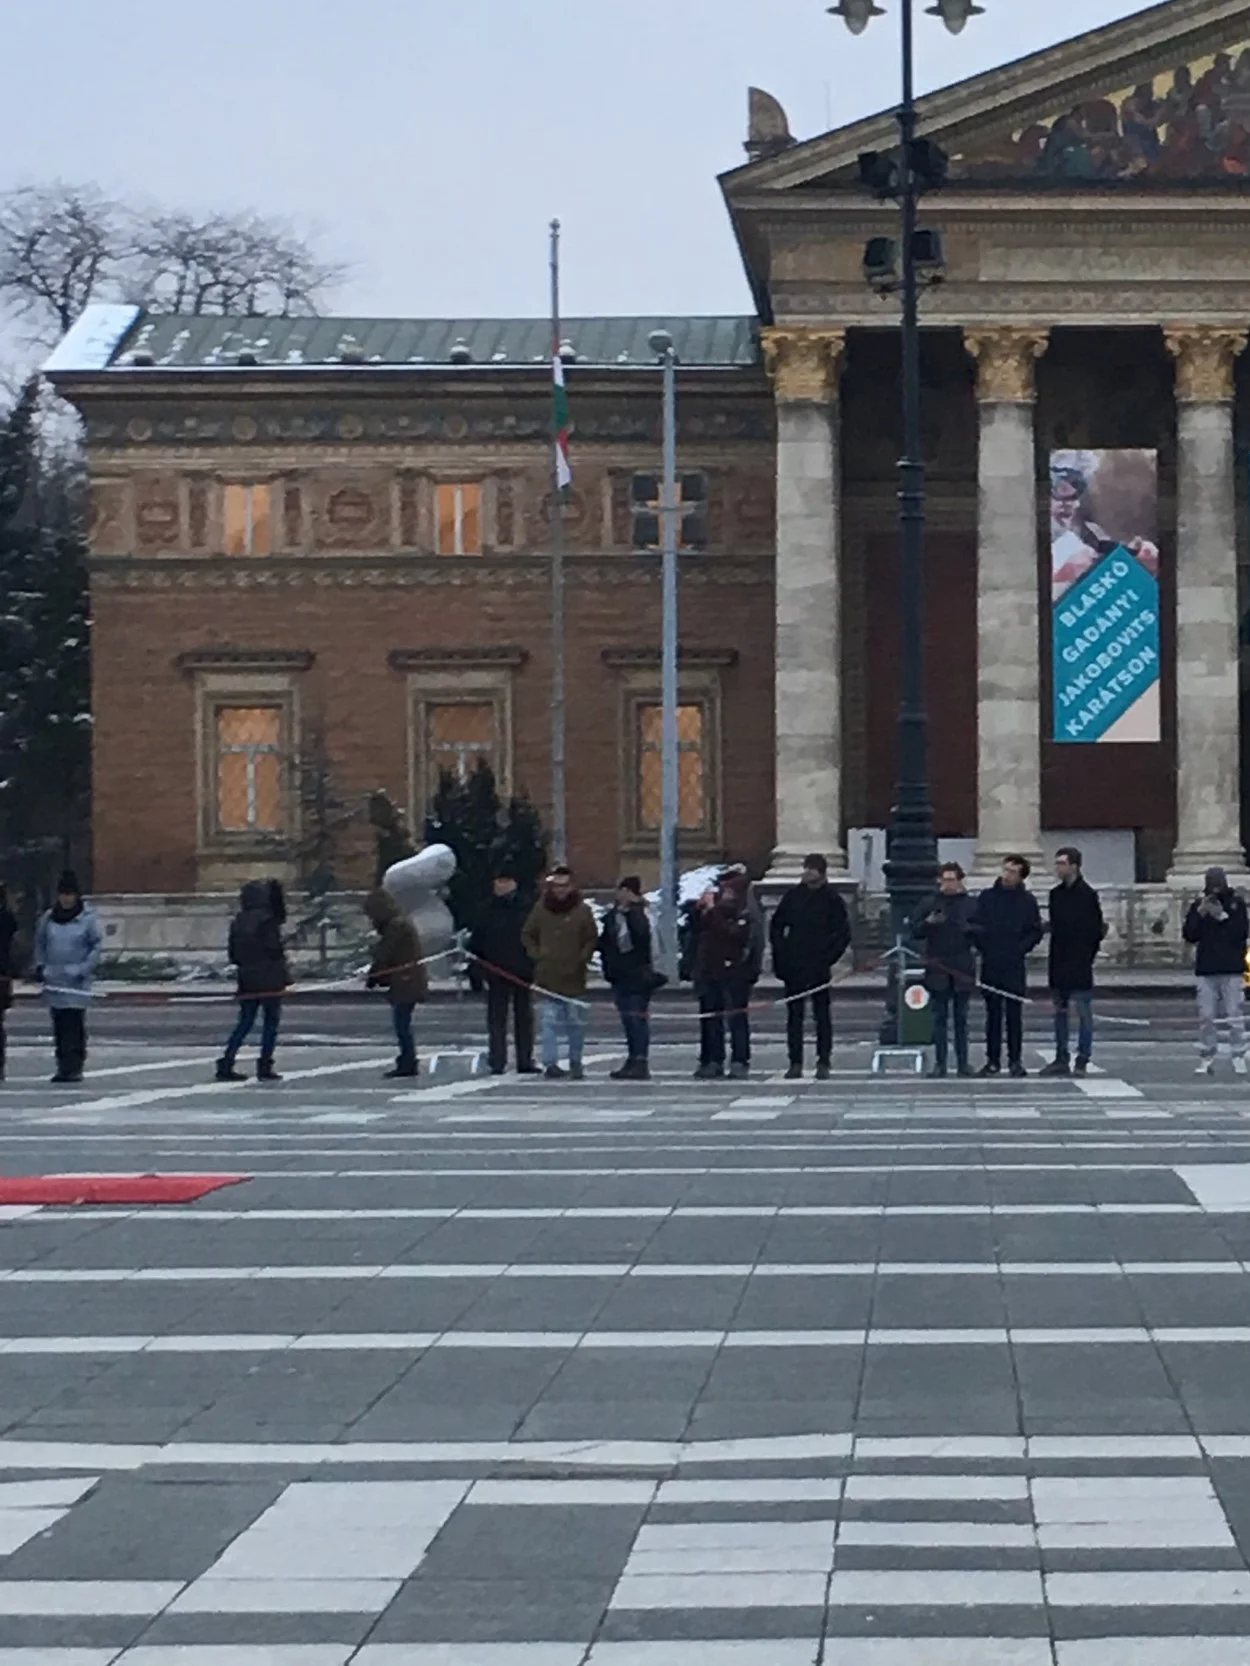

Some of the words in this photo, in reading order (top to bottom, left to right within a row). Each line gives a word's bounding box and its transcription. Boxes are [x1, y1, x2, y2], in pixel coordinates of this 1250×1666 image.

[1059, 560, 1129, 627] BLASKÓ
[1058, 609, 1156, 706] JAKOBOVITS
[1065, 646, 1158, 736] KARÁTSON
